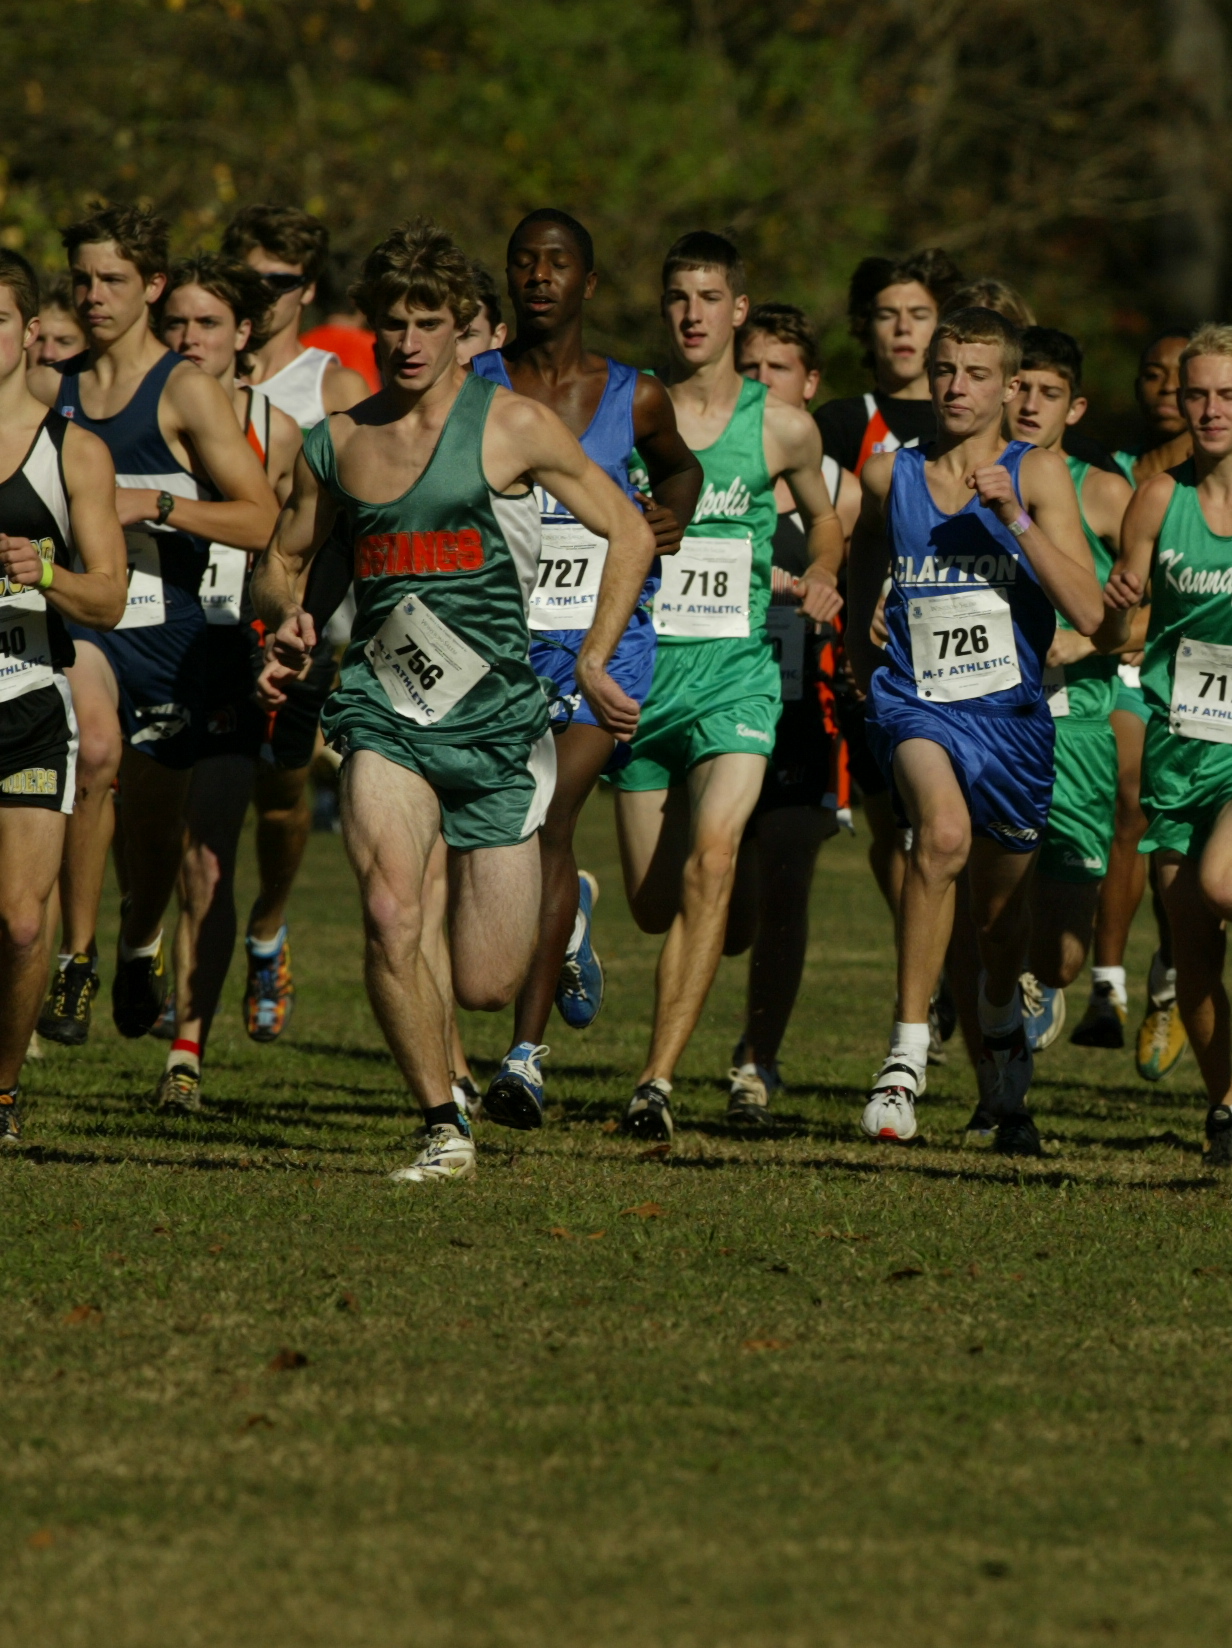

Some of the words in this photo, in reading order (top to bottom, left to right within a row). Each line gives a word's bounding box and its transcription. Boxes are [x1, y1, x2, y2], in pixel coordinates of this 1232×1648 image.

[538, 558, 589, 588] 727
[894, 553, 1019, 583] CLAYTON
[680, 569, 729, 597] 718
[545, 594, 597, 606] ATHLET
[661, 602, 683, 612] M-F
[687, 604, 742, 614] ATHLETIC
[933, 624, 989, 660] 726
[394, 634, 444, 691] 756
[922, 668, 944, 680] M-F
[949, 655, 1011, 676] ATHLETIC
[391, 662, 435, 717] ATHLETIC
[1177, 703, 1199, 716] M-F
